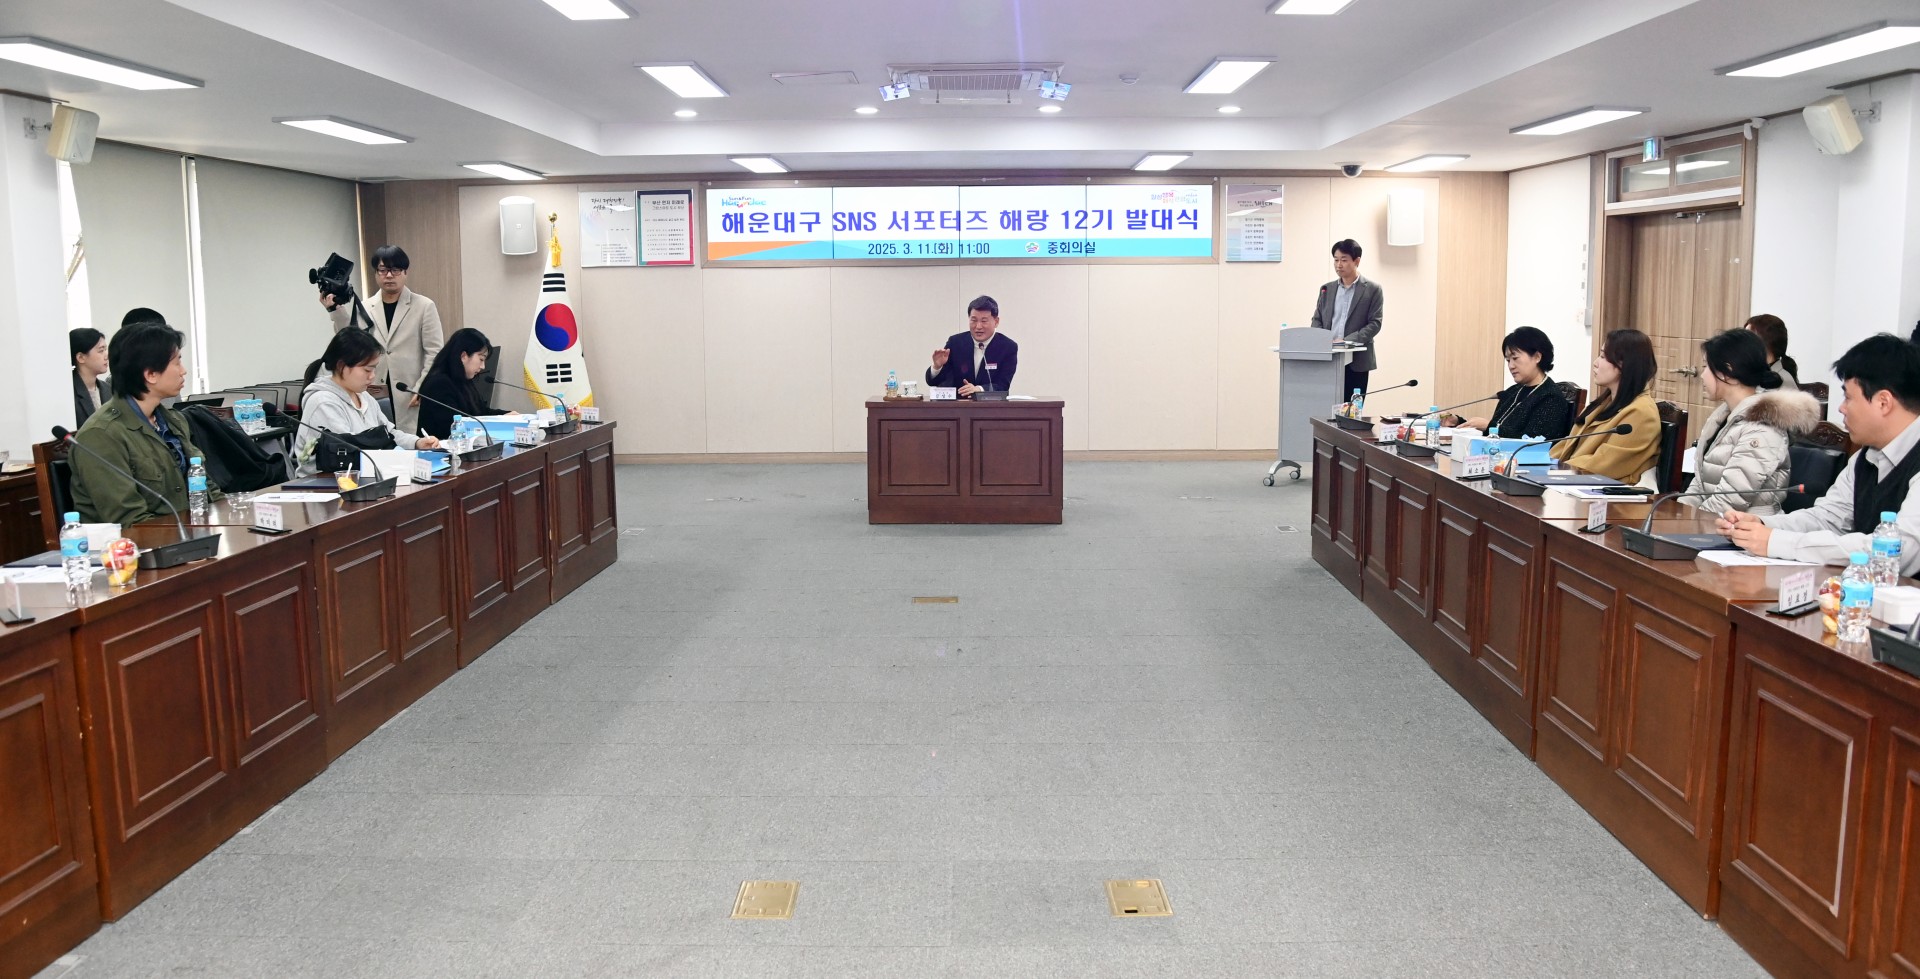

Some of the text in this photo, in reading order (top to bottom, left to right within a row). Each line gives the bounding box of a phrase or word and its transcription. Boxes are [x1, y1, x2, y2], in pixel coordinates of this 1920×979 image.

[721, 209, 1199, 234] 해운대구 SNS 서포터즈 해랑 12기 발대식
[867, 243, 899, 255] 2025.
[903, 243, 913, 254] 3.
[960, 242, 990, 254] 11:00
[1047, 241, 1097, 254] 중회의실
